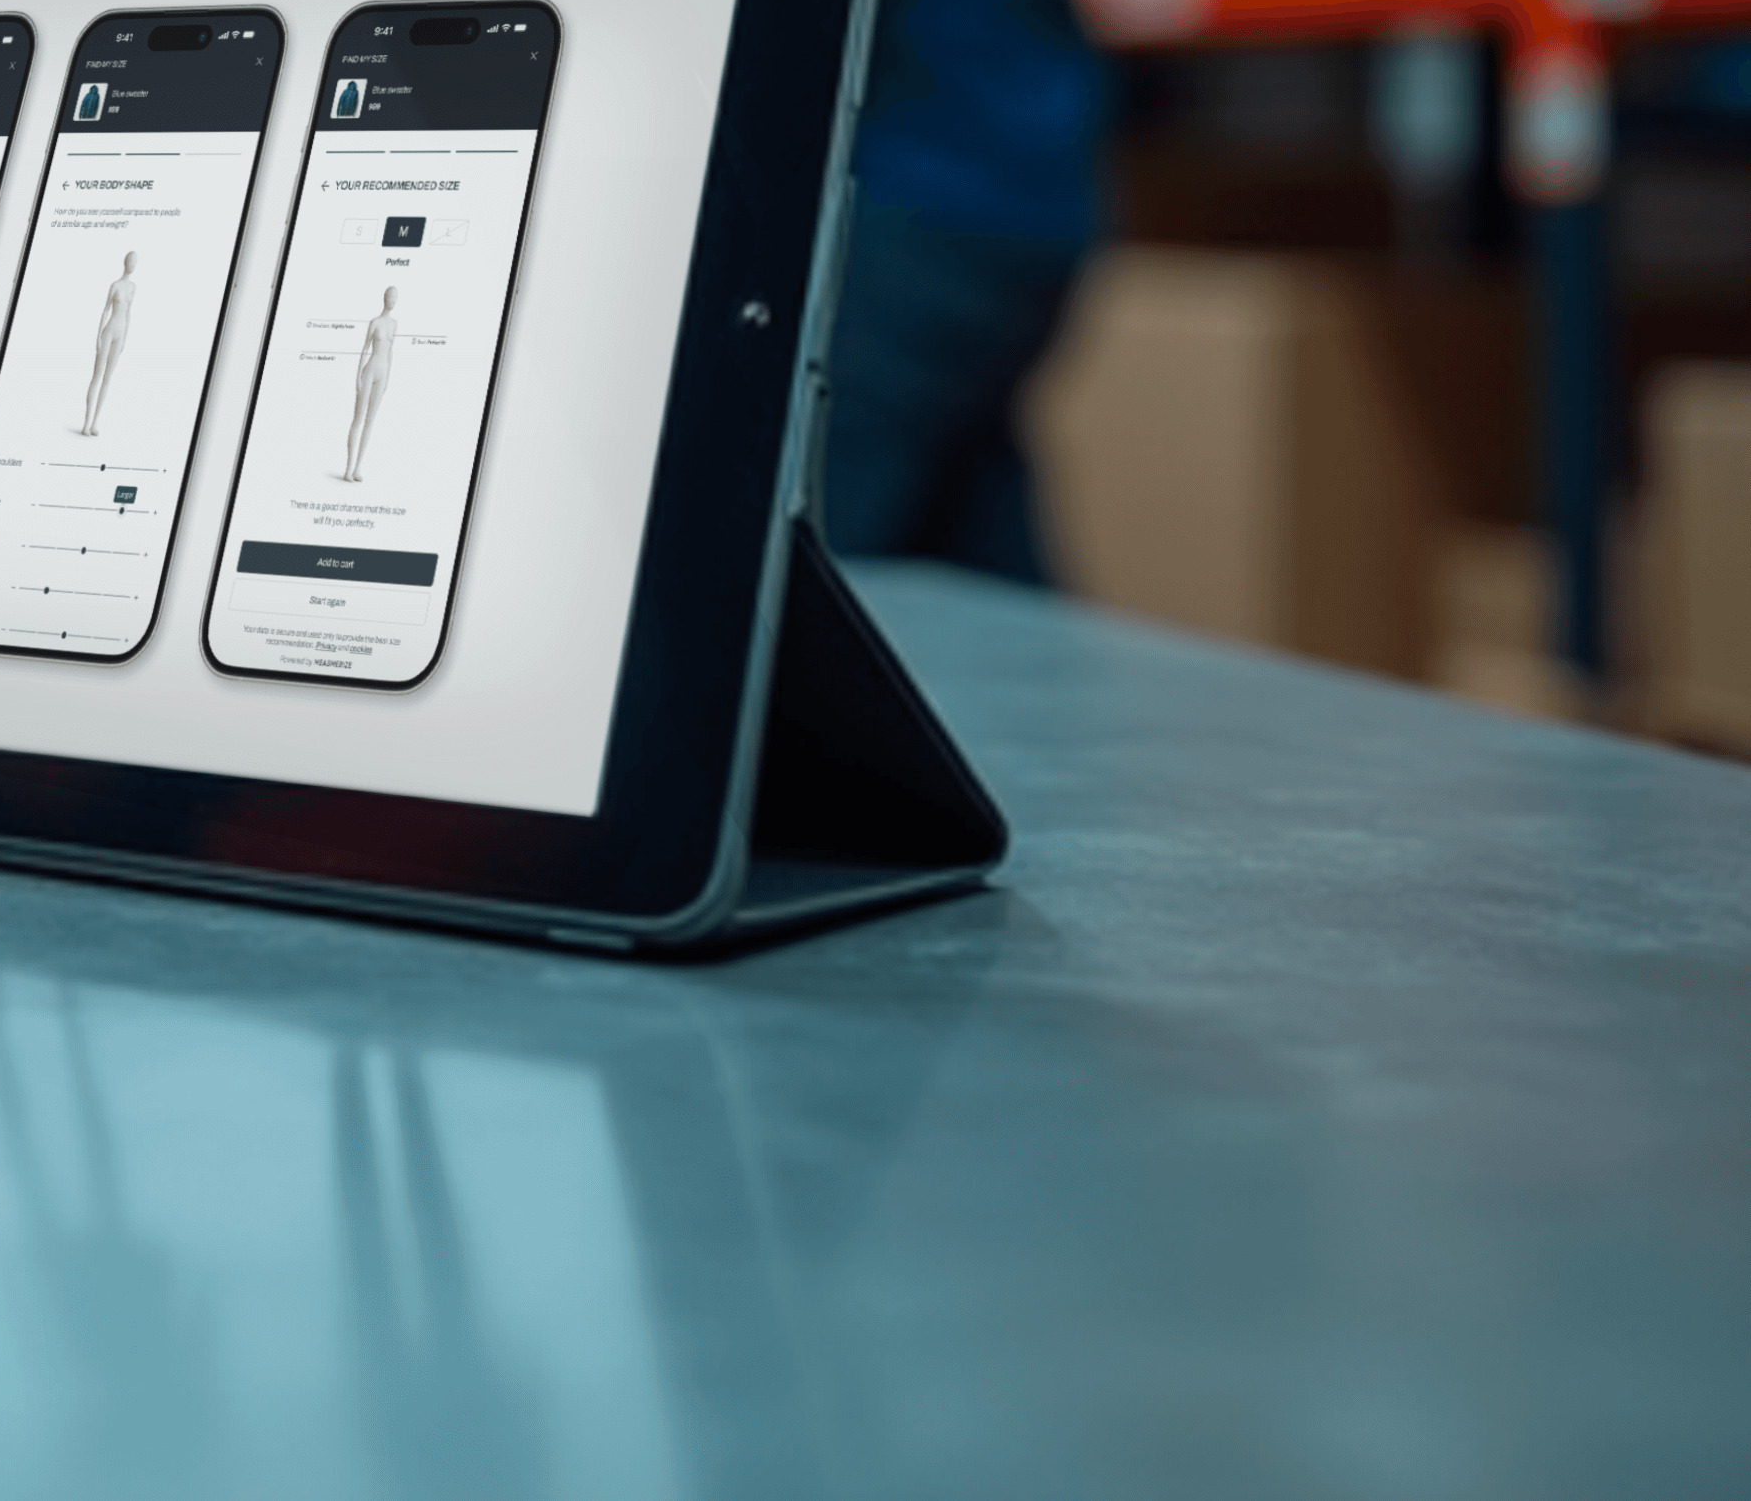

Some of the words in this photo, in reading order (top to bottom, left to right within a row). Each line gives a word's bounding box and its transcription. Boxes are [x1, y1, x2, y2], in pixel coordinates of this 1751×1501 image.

[374, 26, 394, 36] 9:41
[116, 33, 133, 42] 9:41
[112, 60, 128, 68] SIZE
[341, 55, 359, 64] FIND
[371, 54, 388, 63] SIZE
[75, 180, 98, 190] YOUR
[99, 180, 124, 190] BODY
[124, 180, 154, 190] SHAPE
[335, 180, 362, 191] YOUR
[362, 180, 438, 191] RECOMMENDED
[438, 180, 461, 191] SIZE
[398, 225, 409, 238] M
[385, 257, 411, 267] Perfect
[290, 499, 308, 510] There
[321, 503, 339, 513] good
[339, 503, 364, 513] chance
[364, 505, 379, 514] that
[379, 505, 391, 515] this
[391, 507, 407, 516] size
[313, 516, 325, 525] will
[332, 518, 345, 528] you
[316, 557, 333, 567] Add
[340, 560, 355, 569] cart
[309, 596, 326, 606] Start
[327, 598, 347, 608] again
